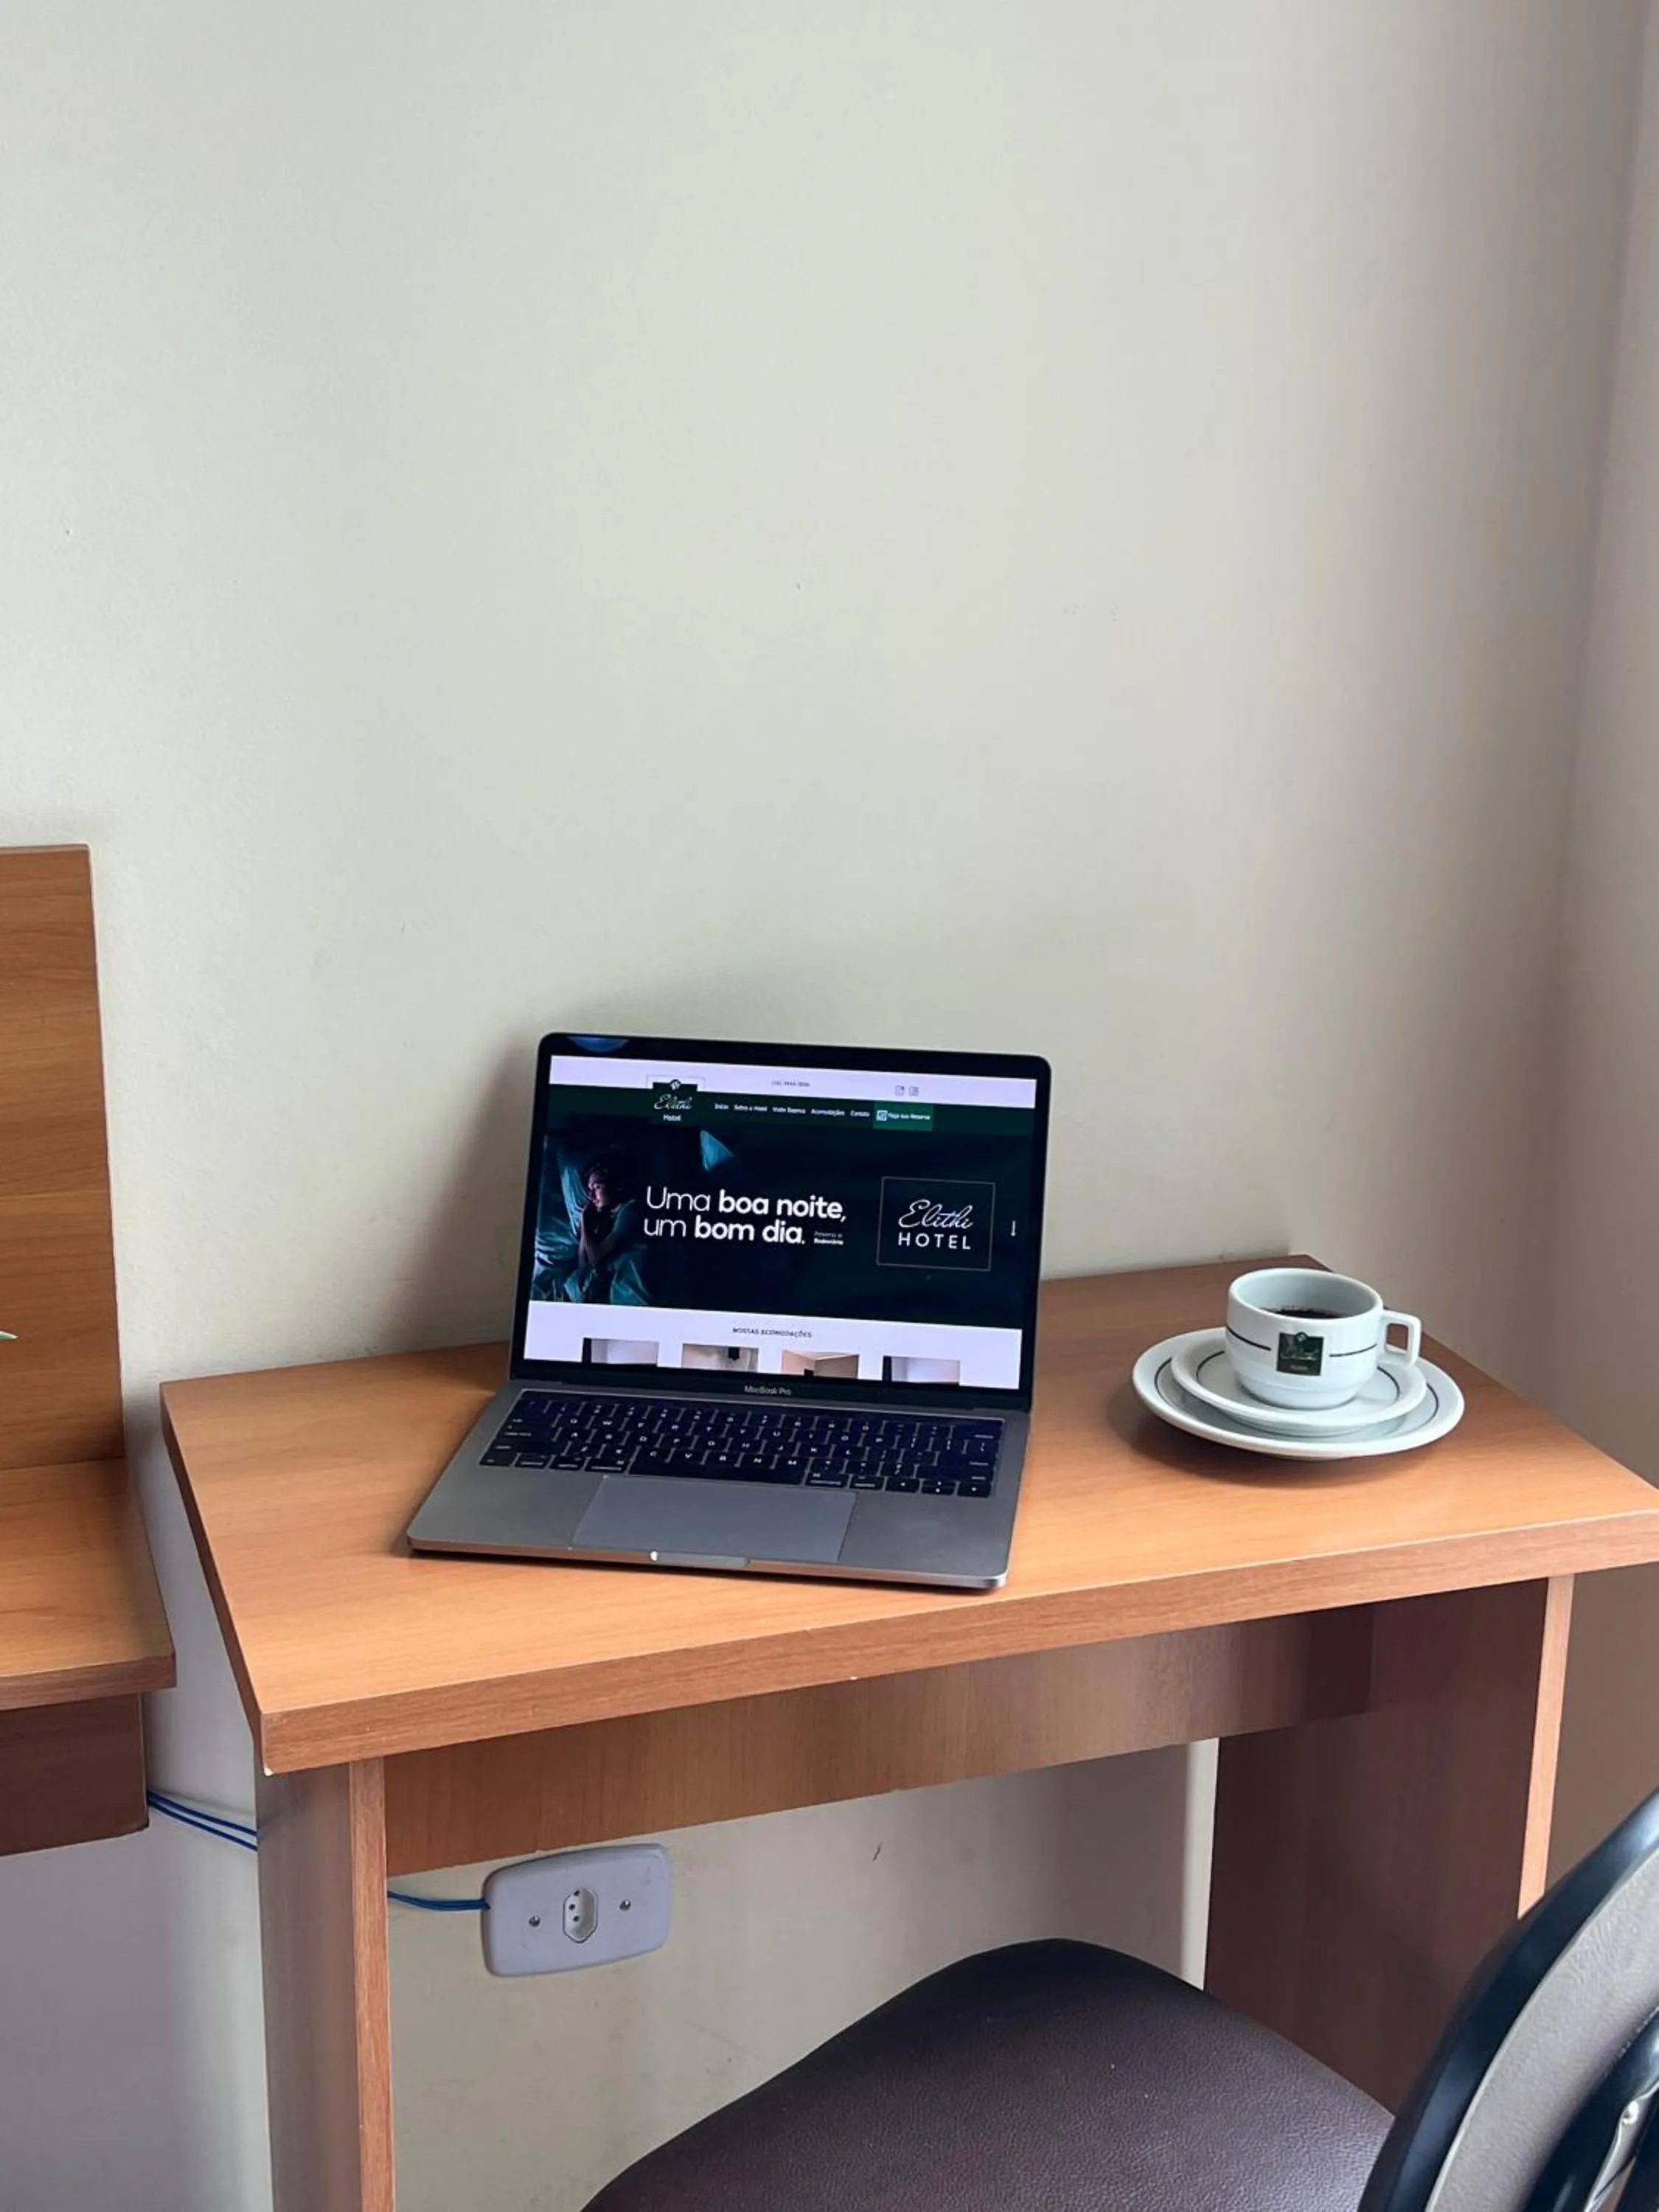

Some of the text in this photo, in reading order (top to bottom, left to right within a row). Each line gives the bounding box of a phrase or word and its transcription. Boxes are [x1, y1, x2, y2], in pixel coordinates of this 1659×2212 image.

[646, 1186, 846, 1222] Uma boa noite,
[644, 1214, 806, 1245] um bom dia.
[897, 1232, 971, 1250] HOTEL
[744, 1385, 792, 1396] MacBook Pro
